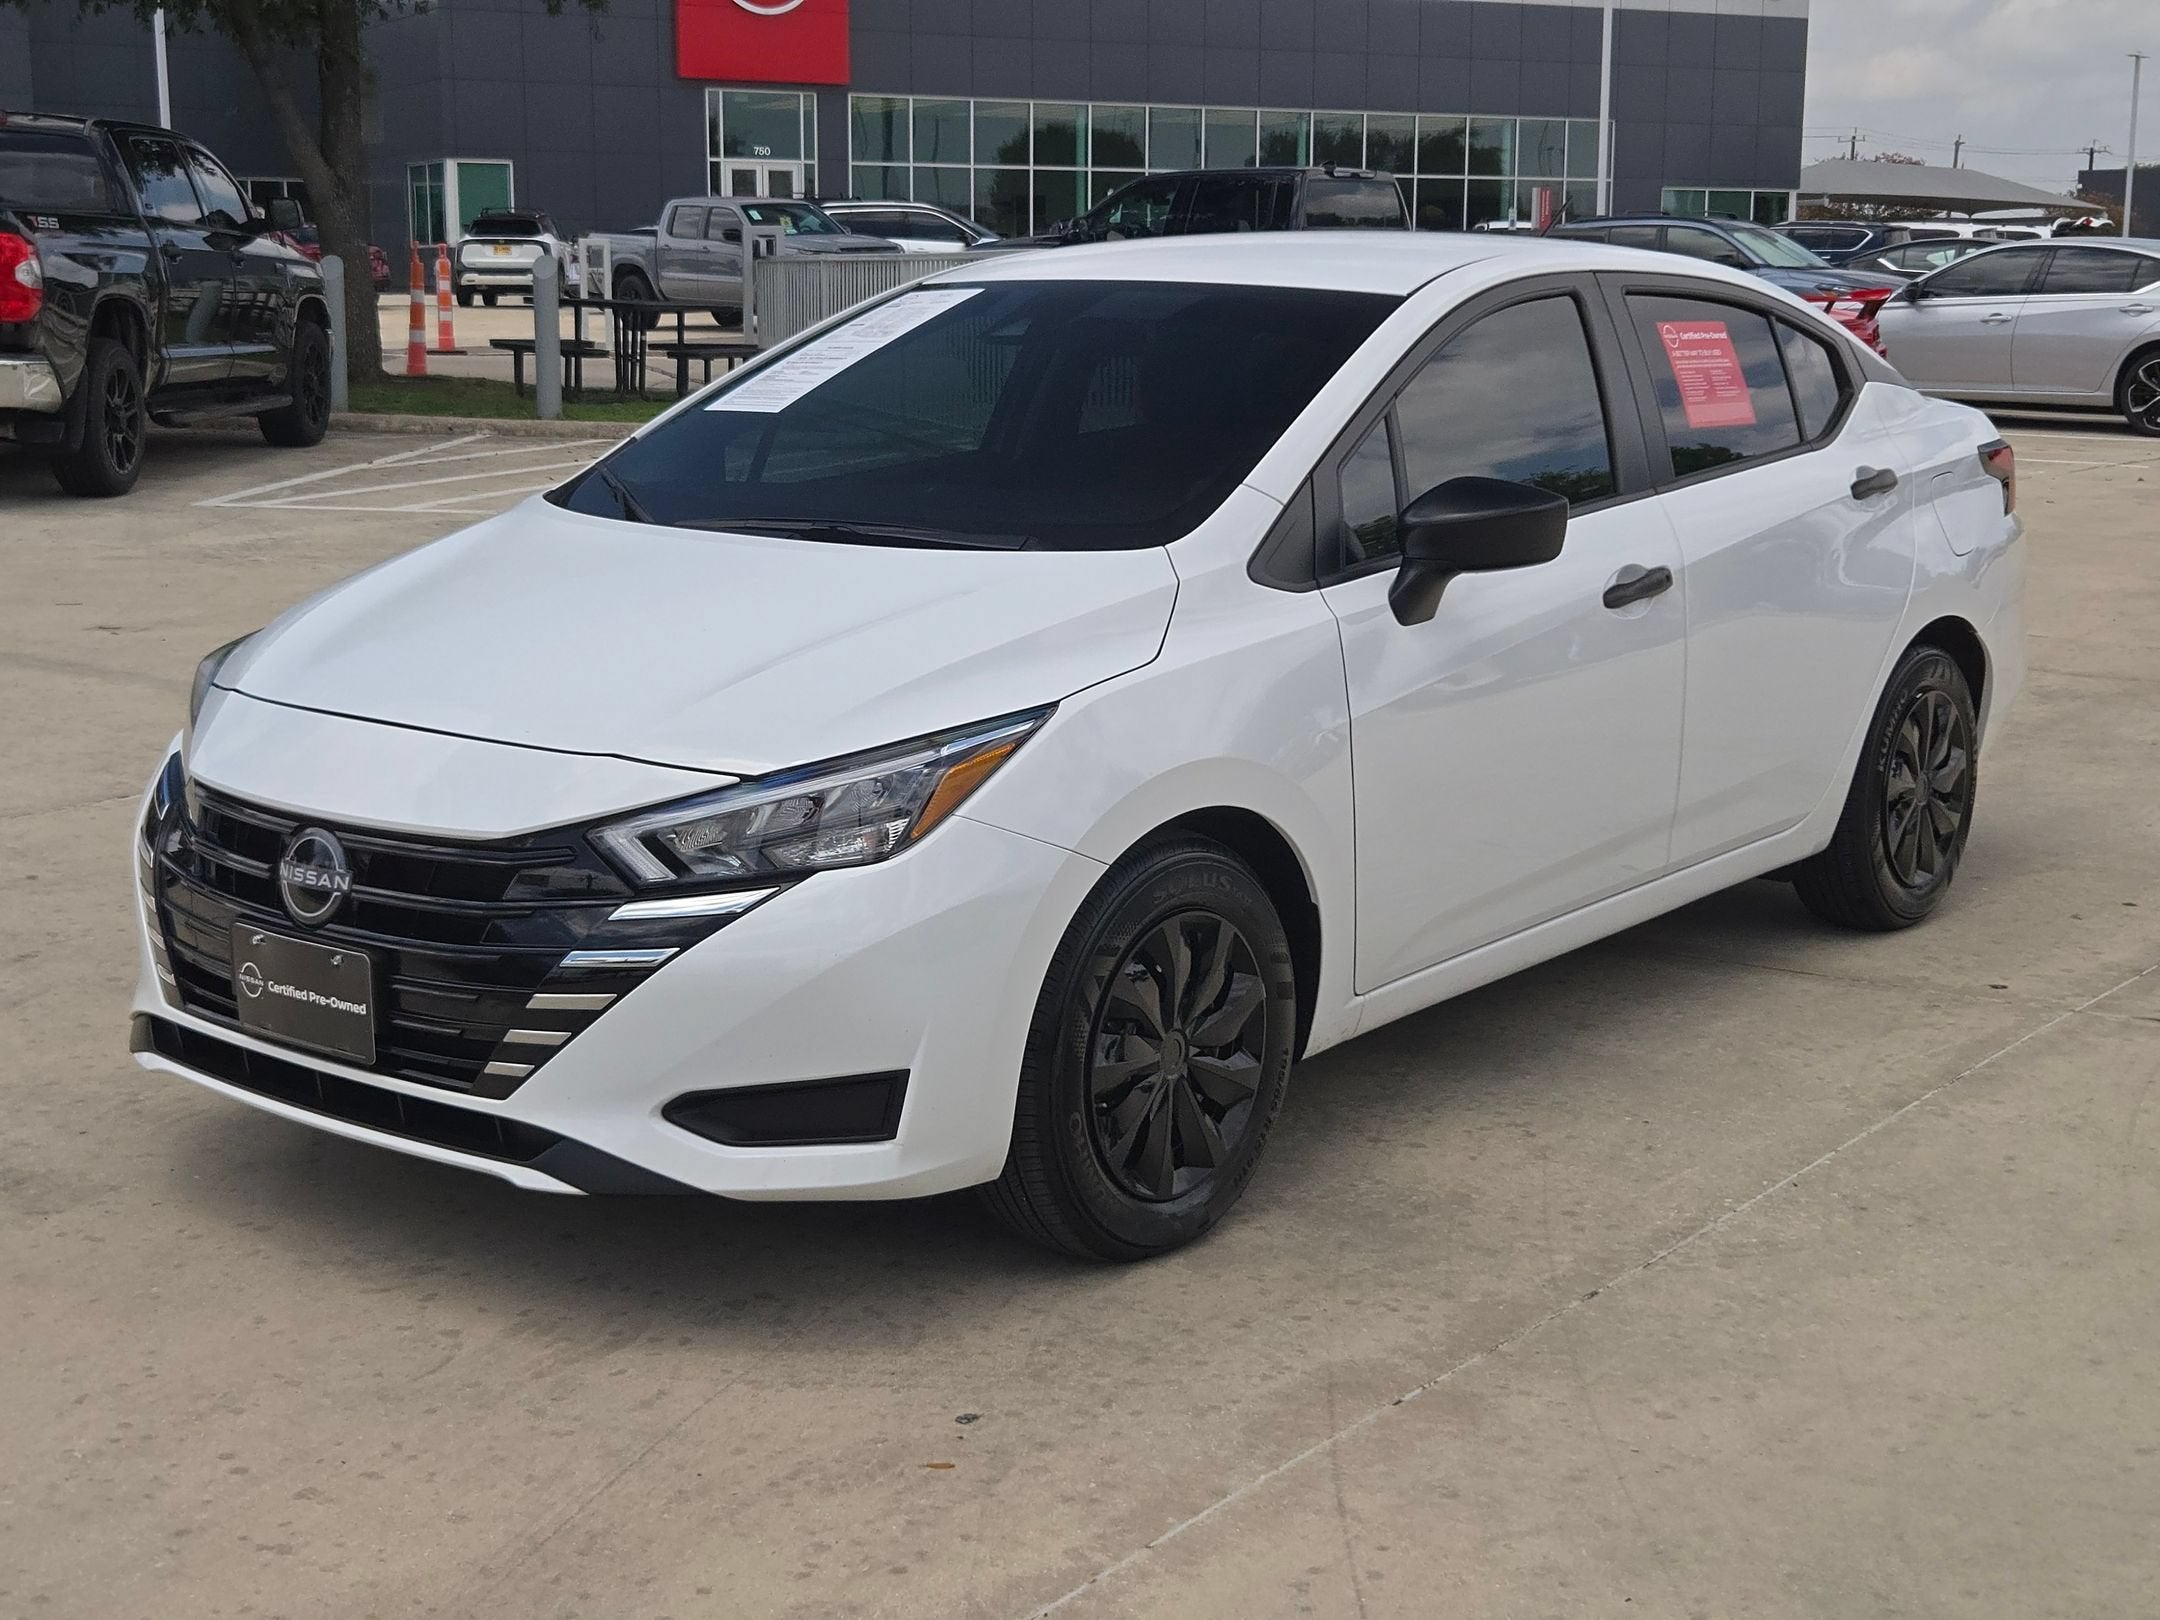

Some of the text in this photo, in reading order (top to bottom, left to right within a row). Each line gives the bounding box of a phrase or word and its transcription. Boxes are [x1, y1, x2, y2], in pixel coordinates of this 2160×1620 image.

[280, 861, 350, 890] NISSAN
[268, 980, 367, 1015] Certified Pre-Owned
